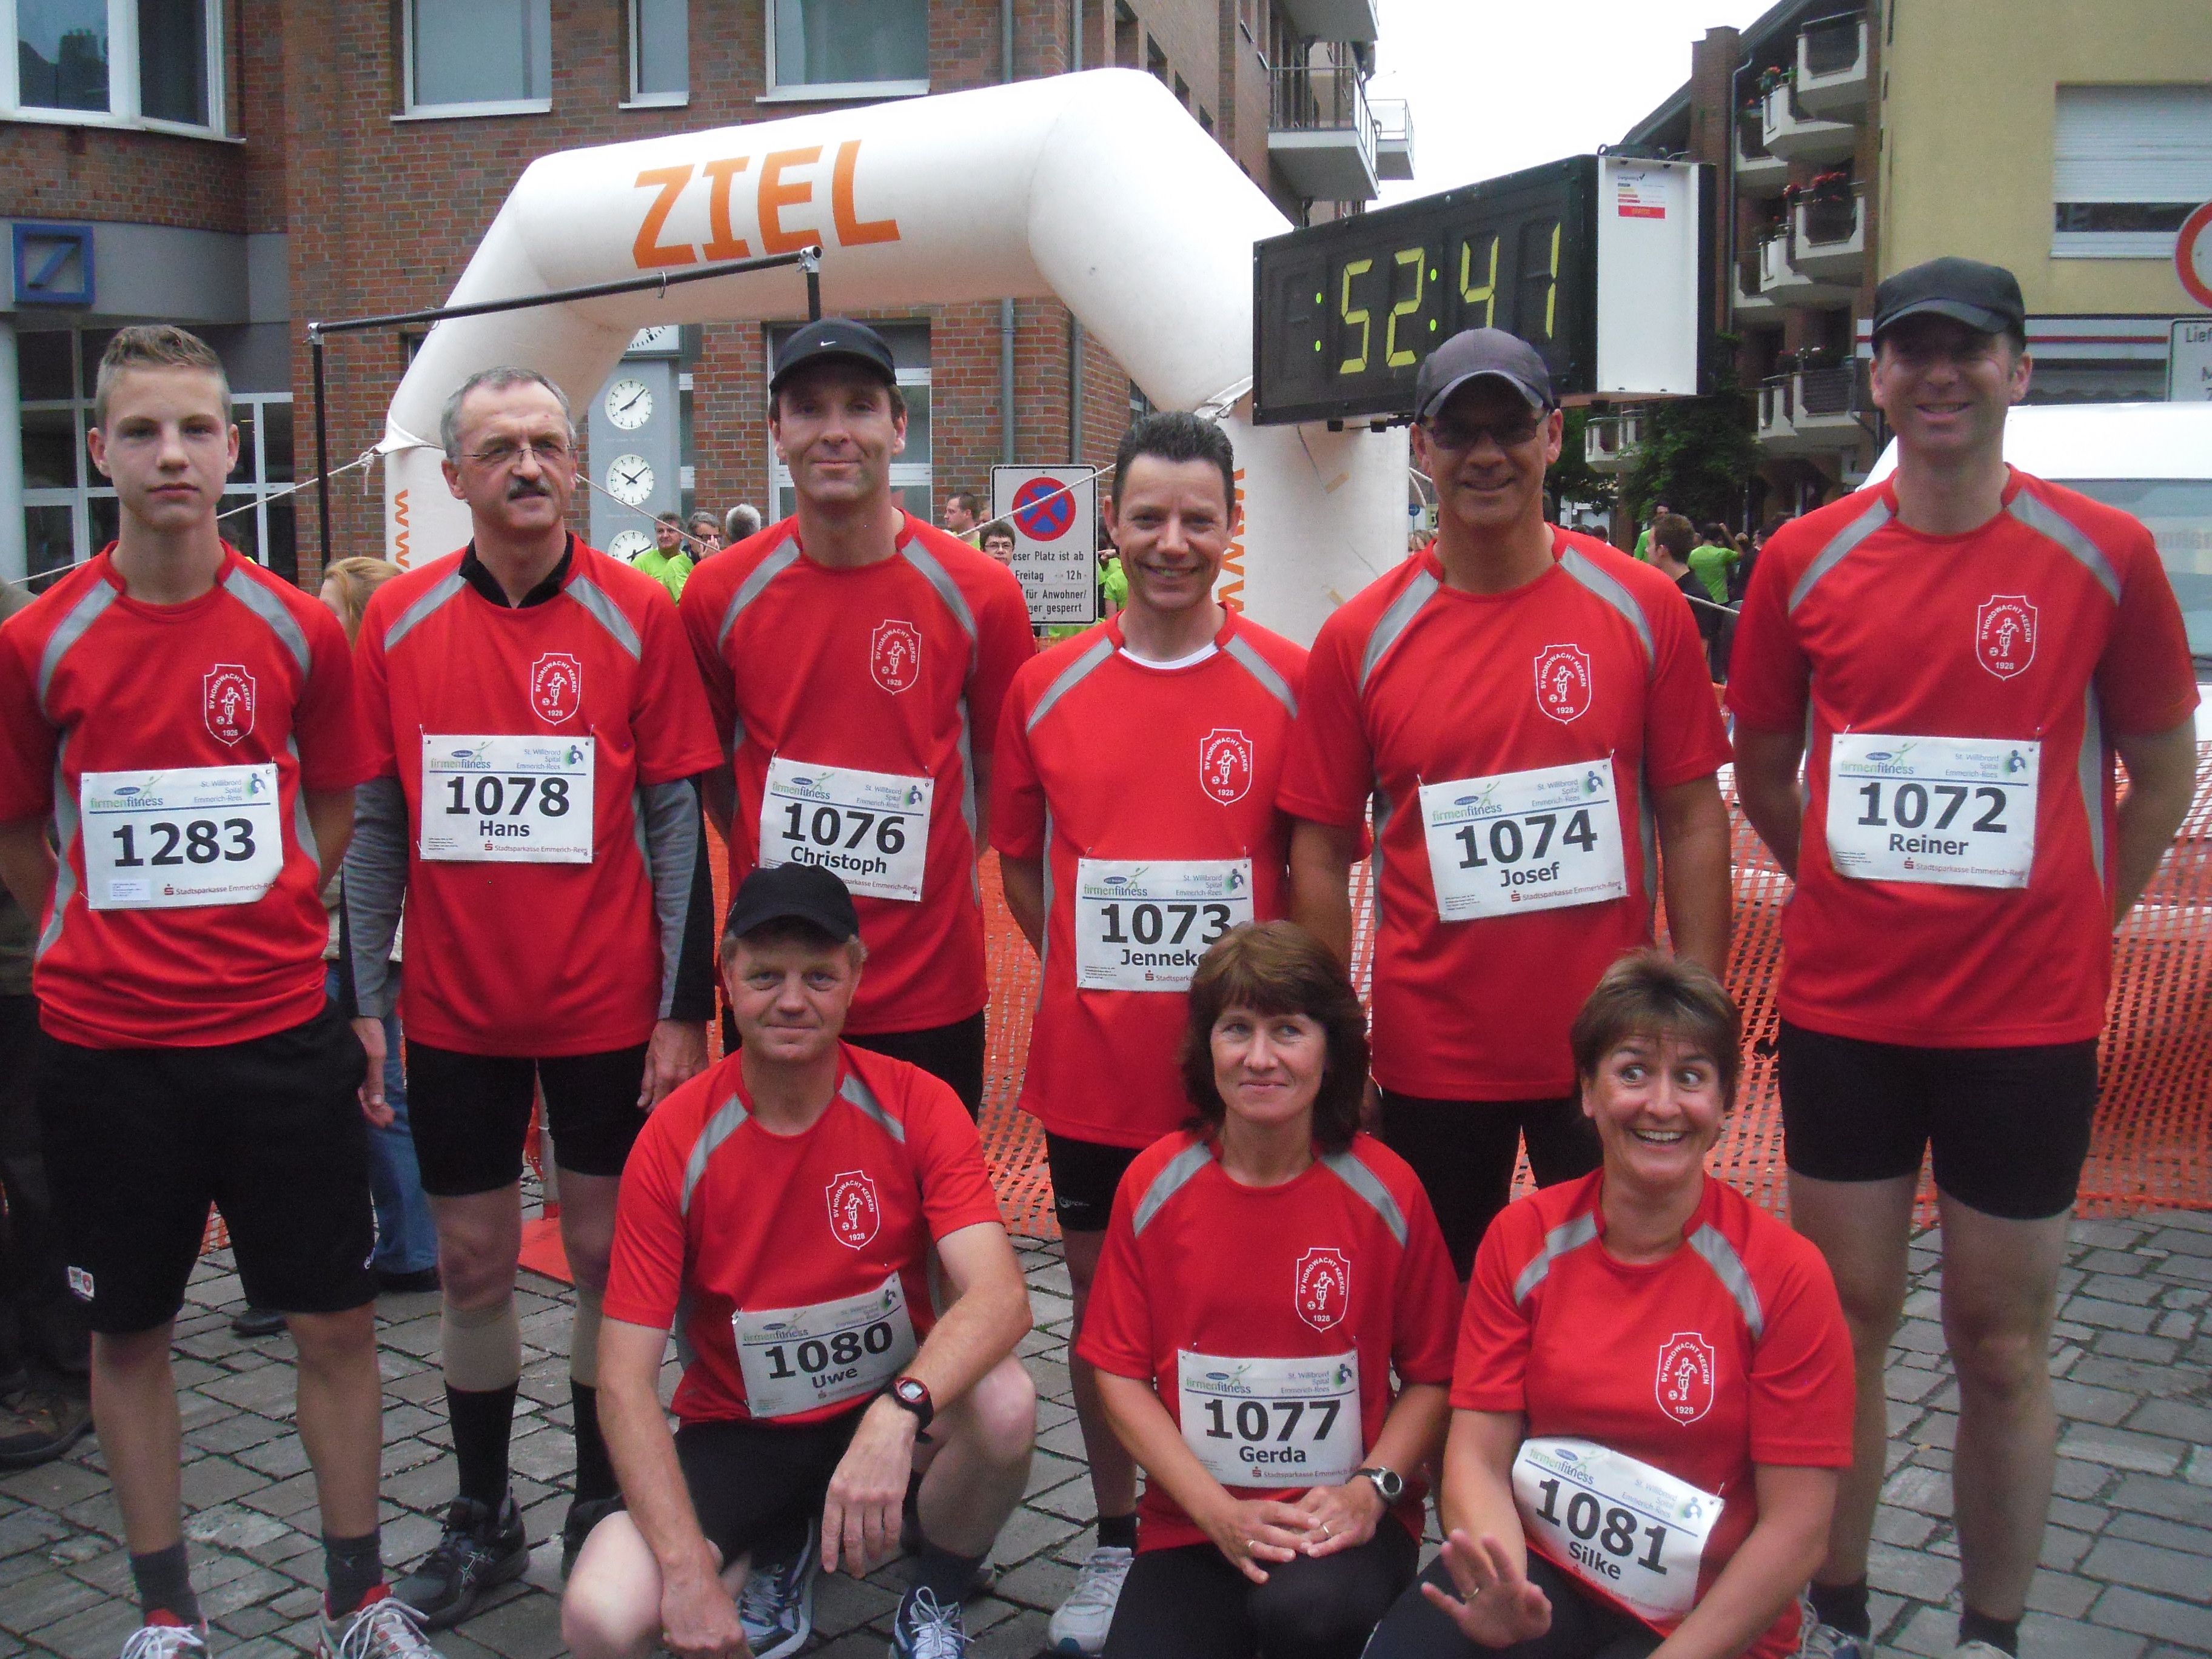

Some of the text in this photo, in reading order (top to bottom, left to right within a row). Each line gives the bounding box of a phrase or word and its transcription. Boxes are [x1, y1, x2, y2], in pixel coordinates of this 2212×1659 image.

[632, 139, 901, 269] ZIEL
[1013, 551, 1084, 561] eser Platz ist ab
[1015, 570, 1044, 582] Freitag
[1026, 589, 1087, 599] für Anwohner/
[1047, 603, 1082, 614] gesperrt
[877, 629, 910, 650] NORDWACHT
[907, 638, 916, 663] KEEKEN
[537, 661, 569, 683] NORDWACHT
[568, 669, 577, 692] KEEKEN
[1541, 652, 1575, 679] NORDWACHT
[1574, 661, 1586, 686] KEEKEN
[431, 759, 491, 769] firmenfitness
[1206, 737, 1239, 760] NORDWACHT
[1238, 746, 1248, 771] KEEKEN
[90, 797, 163, 808] firmenfitness
[446, 776, 569, 817] 1078
[773, 782, 830, 799] firmenfitness
[1432, 804, 1502, 821] firmenfitness
[1858, 782, 2006, 833] 1072
[113, 818, 255, 867] 1283
[480, 820, 530, 837] Hans
[782, 803, 905, 854] 1076
[1455, 809, 1598, 869] 1074
[1889, 833, 1969, 855] Reiner
[791, 846, 886, 875] Christoph
[1501, 862, 1560, 887] Josef
[176, 885, 227, 895] Stadtsparkasse
[1084, 885, 1147, 896] firmenfitness
[1523, 888, 1572, 900] Stadtsparkasse
[1101, 903, 1232, 945] 1073
[834, 1180, 862, 1207] NORDWACHT
[862, 1187, 874, 1212] KEEKEN
[850, 1233, 865, 1241] 1928
[1302, 1258, 1336, 1283] NORDWACHT
[1335, 1267, 1345, 1295] KEEKEN
[765, 1321, 893, 1379] 1080
[1664, 1342, 1700, 1372] NORDWACHT
[1698, 1353, 1709, 1384] KEEKEN
[813, 1367, 857, 1389] Uwe
[1187, 1378, 1251, 1394] firmenfitness
[1205, 1399, 1340, 1441] 1077
[1239, 1446, 1306, 1463] Gerda
[1536, 1478, 1667, 1576] 1081
[1569, 1541, 1621, 1580] Silke
